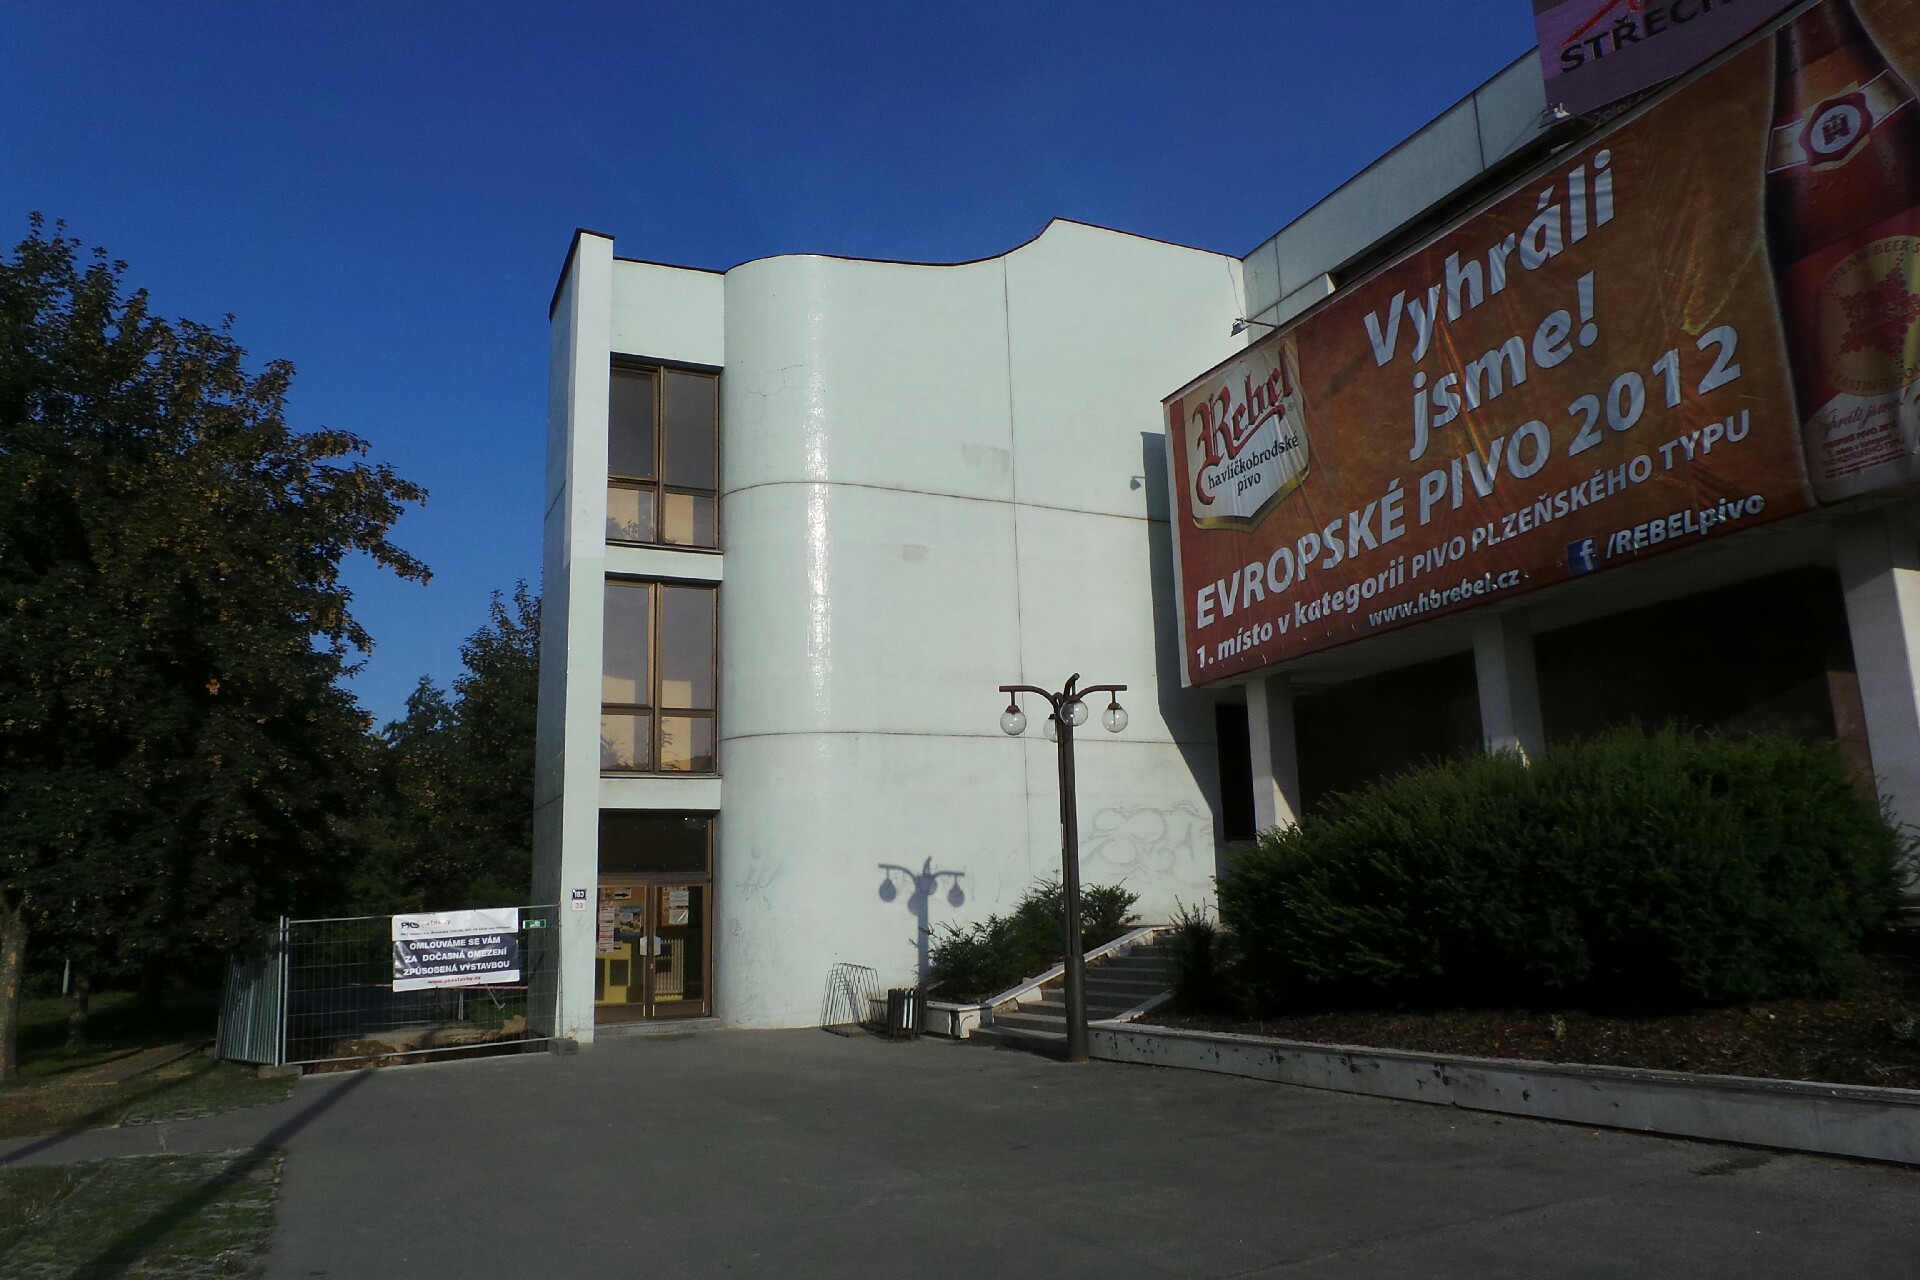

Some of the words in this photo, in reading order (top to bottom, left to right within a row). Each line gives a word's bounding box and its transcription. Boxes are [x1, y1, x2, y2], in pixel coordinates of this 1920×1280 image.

[1363, 148, 1615, 368] Vyhráli
[1409, 271, 1599, 461] jsme!
[1192, 343, 1294, 505] Rebel
[1197, 478, 1406, 630] EVROPSKÉ
[1419, 419, 1551, 526] PIVO
[1568, 325, 1741, 457] 2012
[1208, 431, 1300, 490] havlíčkobrodské
[1237, 472, 1262, 496] pivo
[1196, 644, 1214, 669] 1.
[1217, 622, 1273, 661] místo
[1277, 613, 1291, 634] v
[1294, 556, 1404, 628] kategorii
[1411, 535, 1466, 579] PIVO
[1472, 454, 1653, 552] PLZEŇSKÉHO
[1659, 409, 1750, 471] TYPU
[1368, 569, 1520, 627] www.hbrebel.cz
[404, 955, 418, 964] ZA
[422, 951, 466, 962] DOČASNÁ
[467, 946, 508, 958] OMEZENÍ
[409, 938, 467, 950] OMLOUVÁME
[468, 938, 480, 946] SE
[482, 936, 501, 945] VÁM
[459, 960, 510, 972] VÝSTAVBOU
